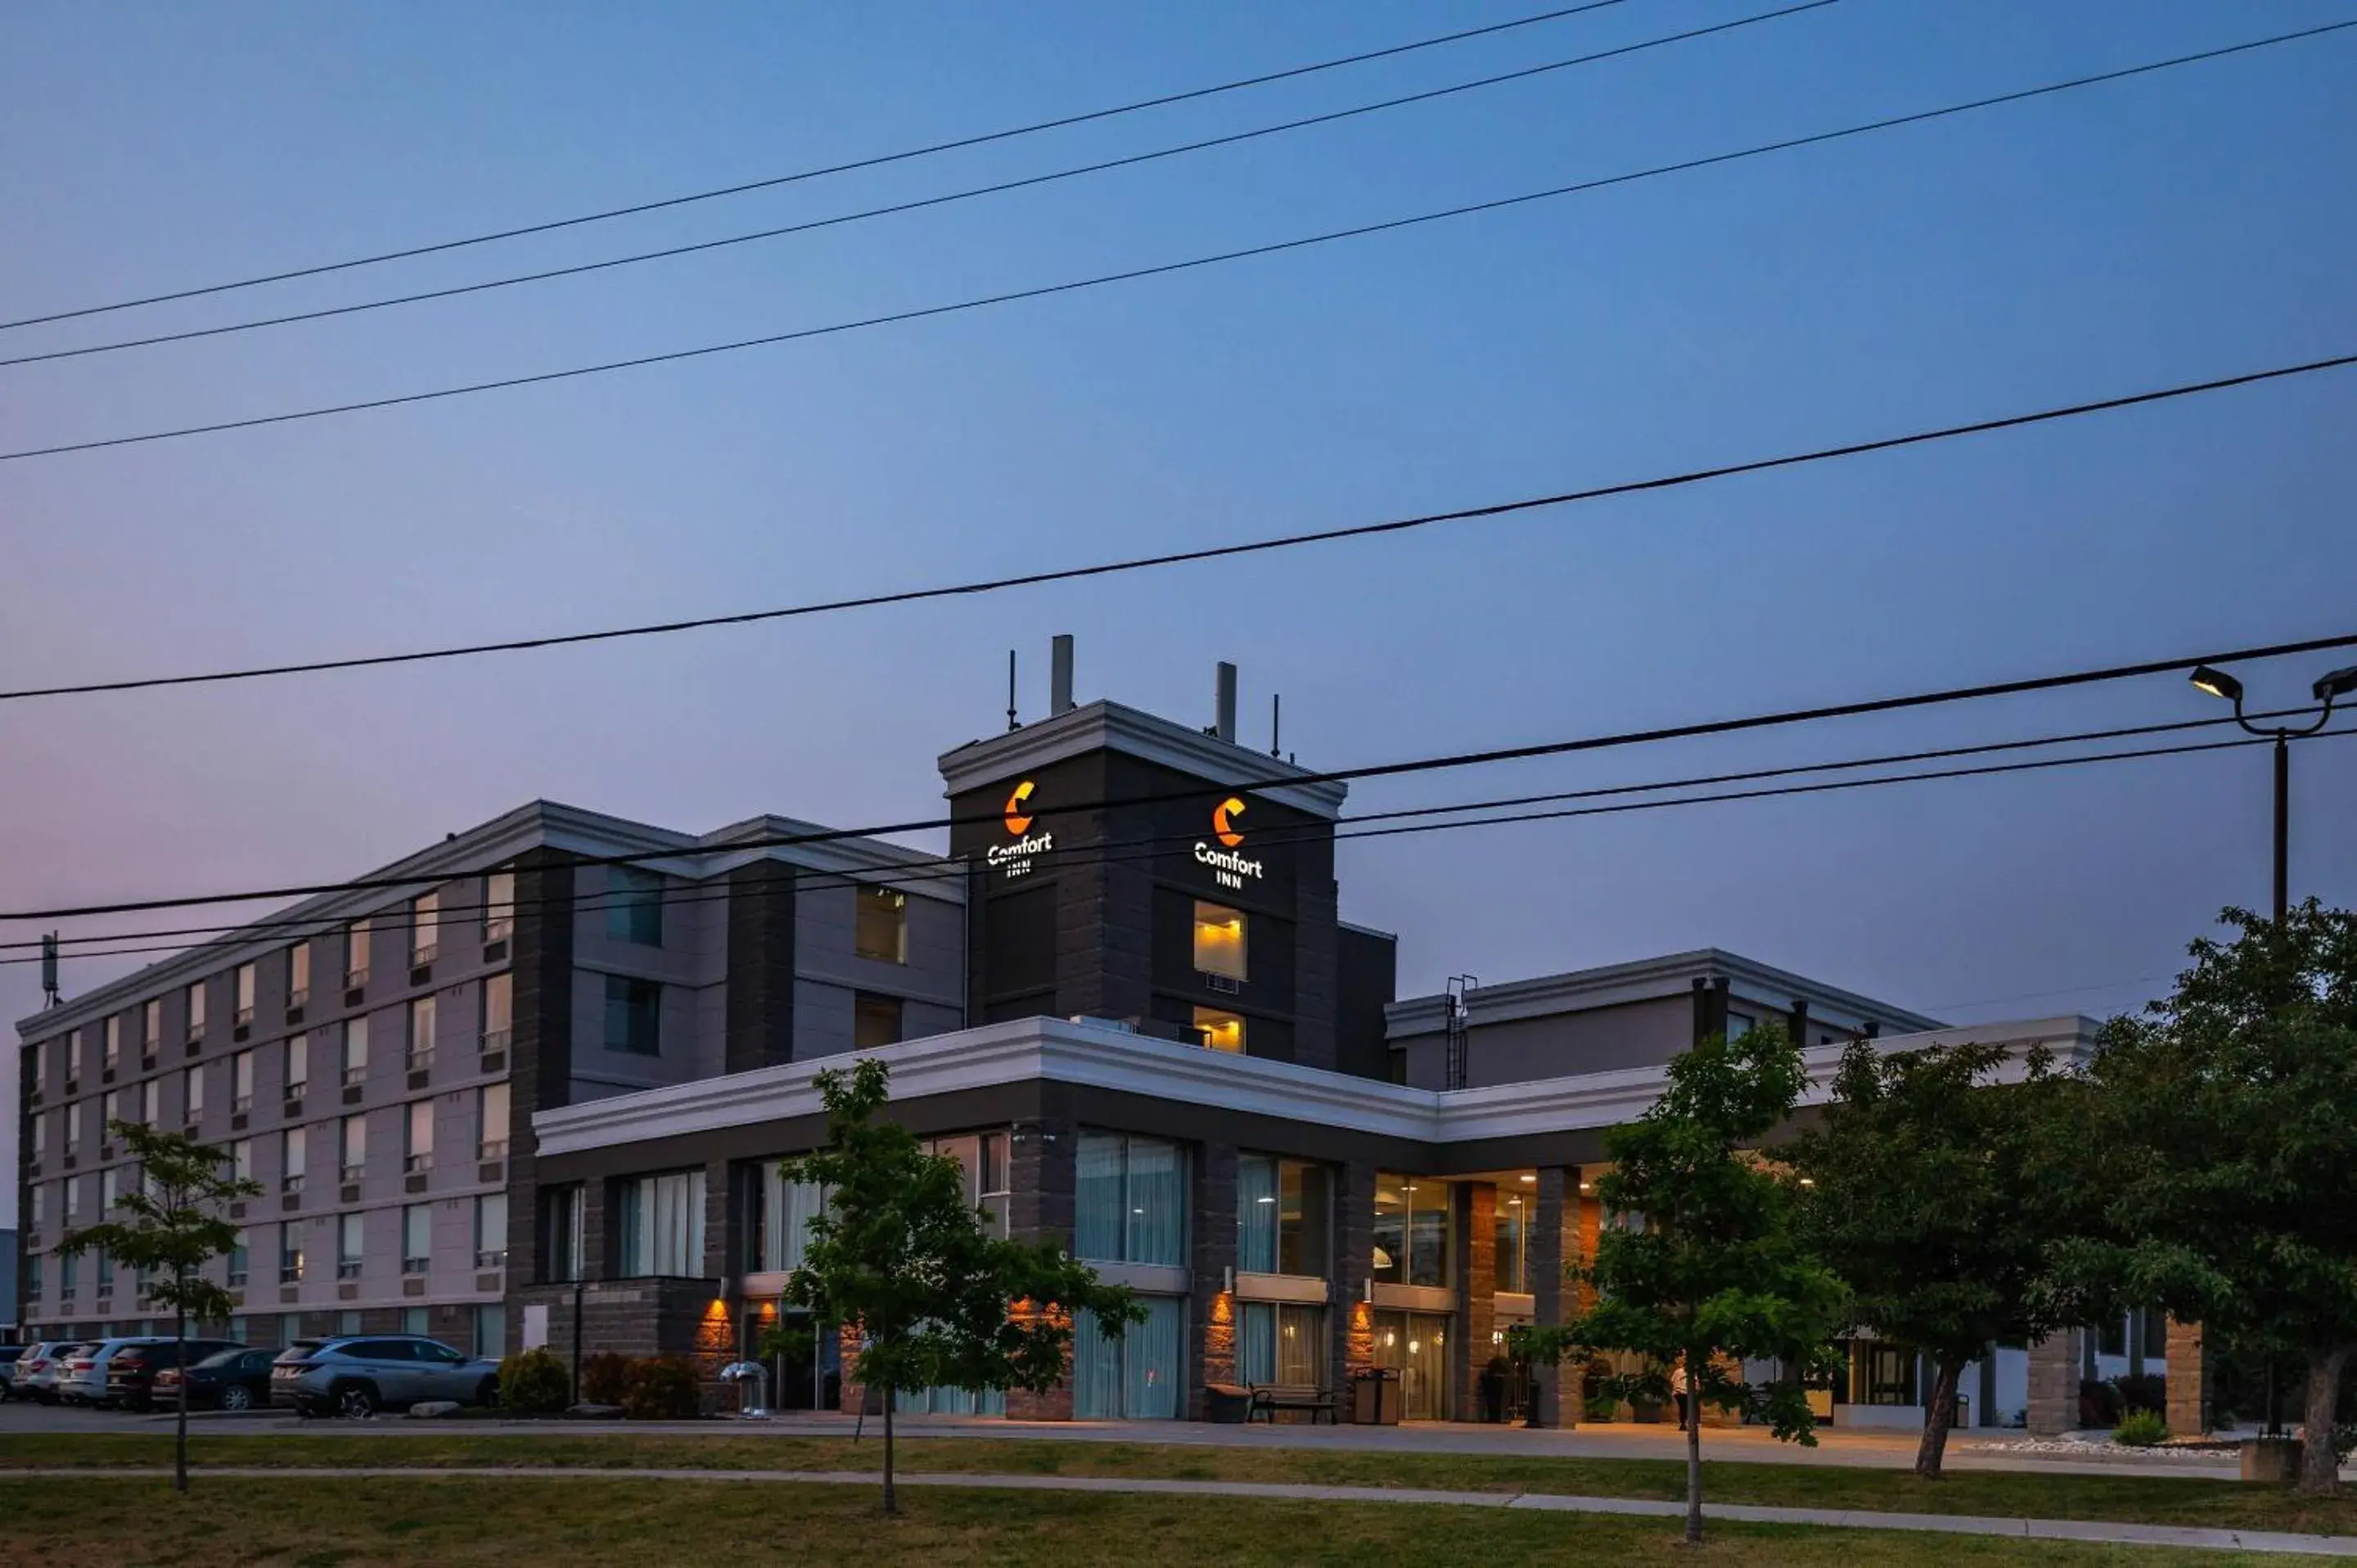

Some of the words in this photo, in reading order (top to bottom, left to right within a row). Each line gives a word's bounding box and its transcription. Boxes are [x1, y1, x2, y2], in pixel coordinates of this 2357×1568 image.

[987, 831, 1052, 866] Comfort
[1194, 842, 1263, 879] Comfort
[1006, 859, 1030, 878] INN
[1216, 870, 1242, 890] INN
